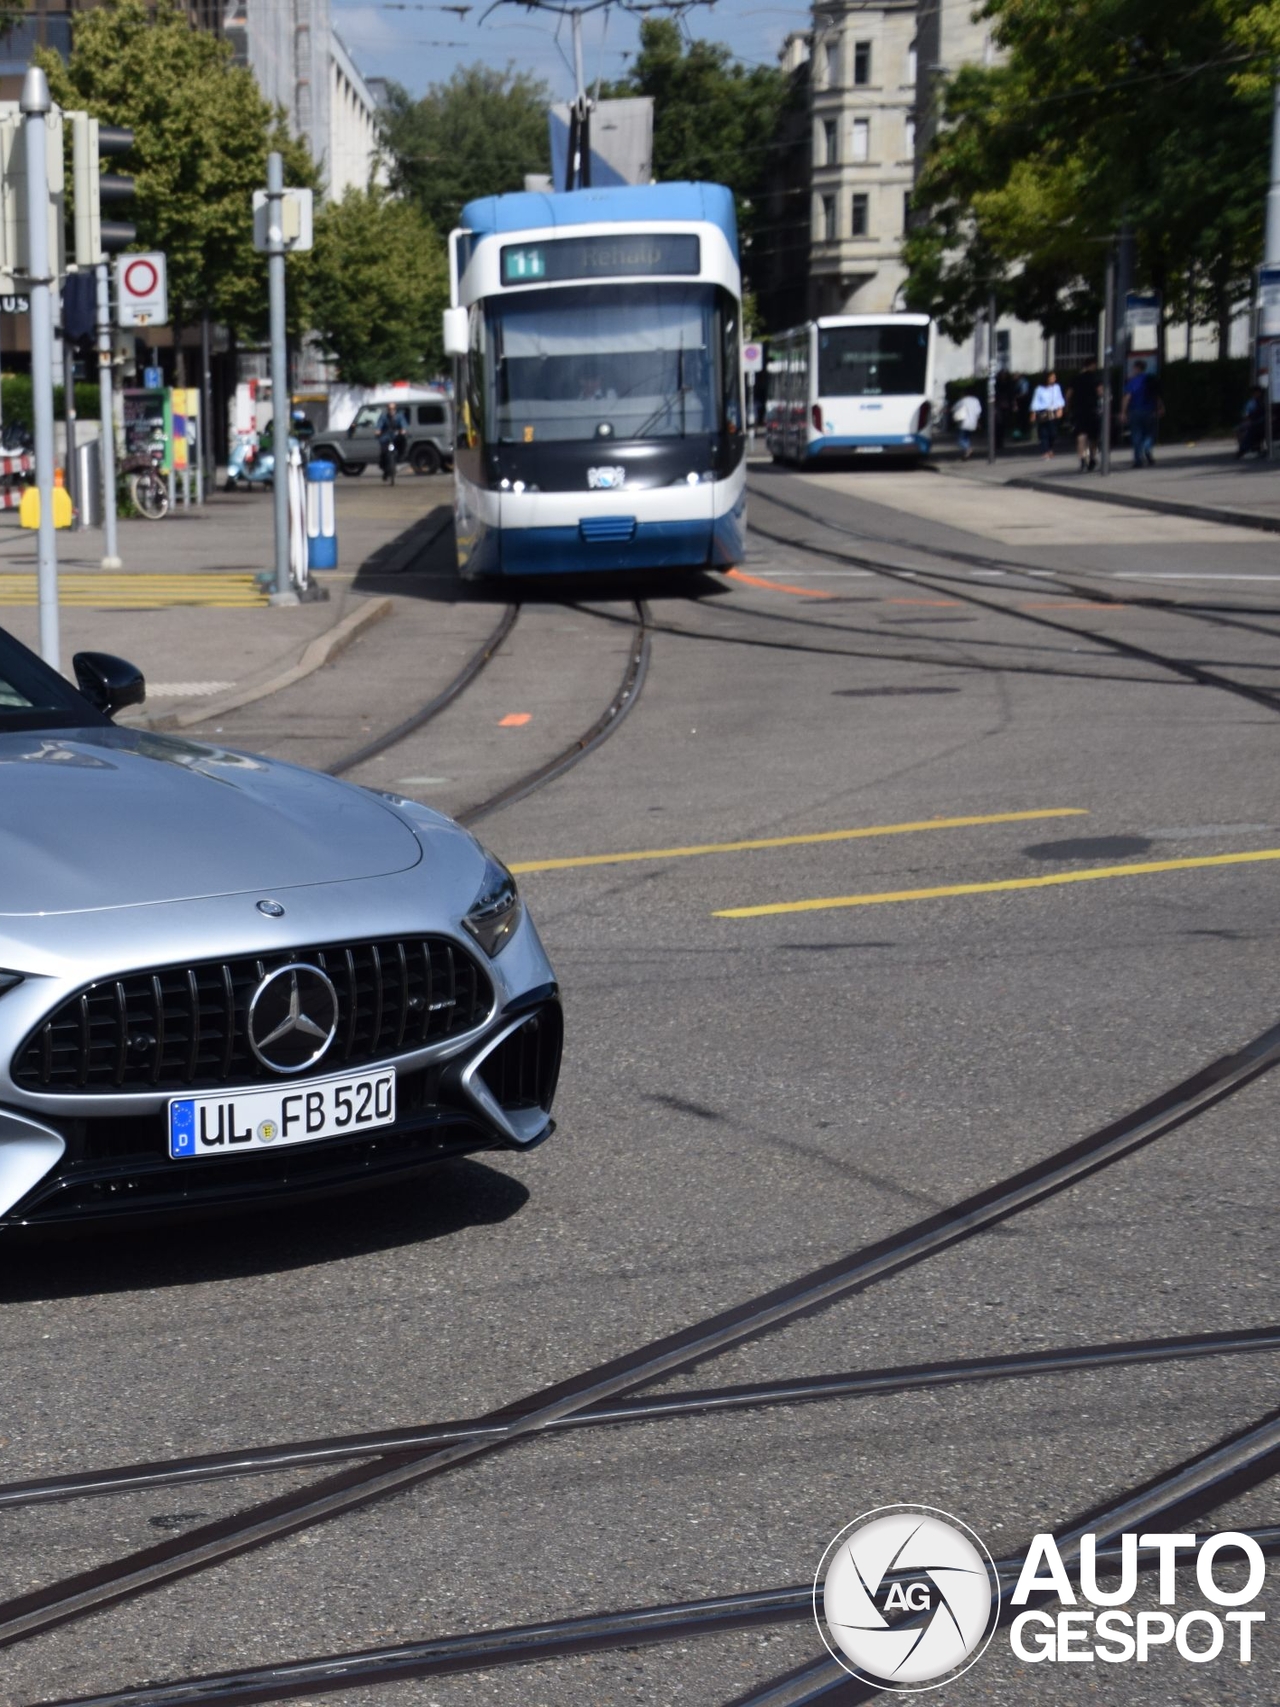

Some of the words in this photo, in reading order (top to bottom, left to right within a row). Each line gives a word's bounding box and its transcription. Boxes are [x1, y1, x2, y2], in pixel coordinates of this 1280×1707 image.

[514, 250, 540, 275] 11
[583, 244, 662, 268] Rehalp
[178, 1134, 189, 1147] D
[200, 1103, 253, 1147] UL
[281, 1091, 326, 1138] FB
[334, 1076, 393, 1128] 520
